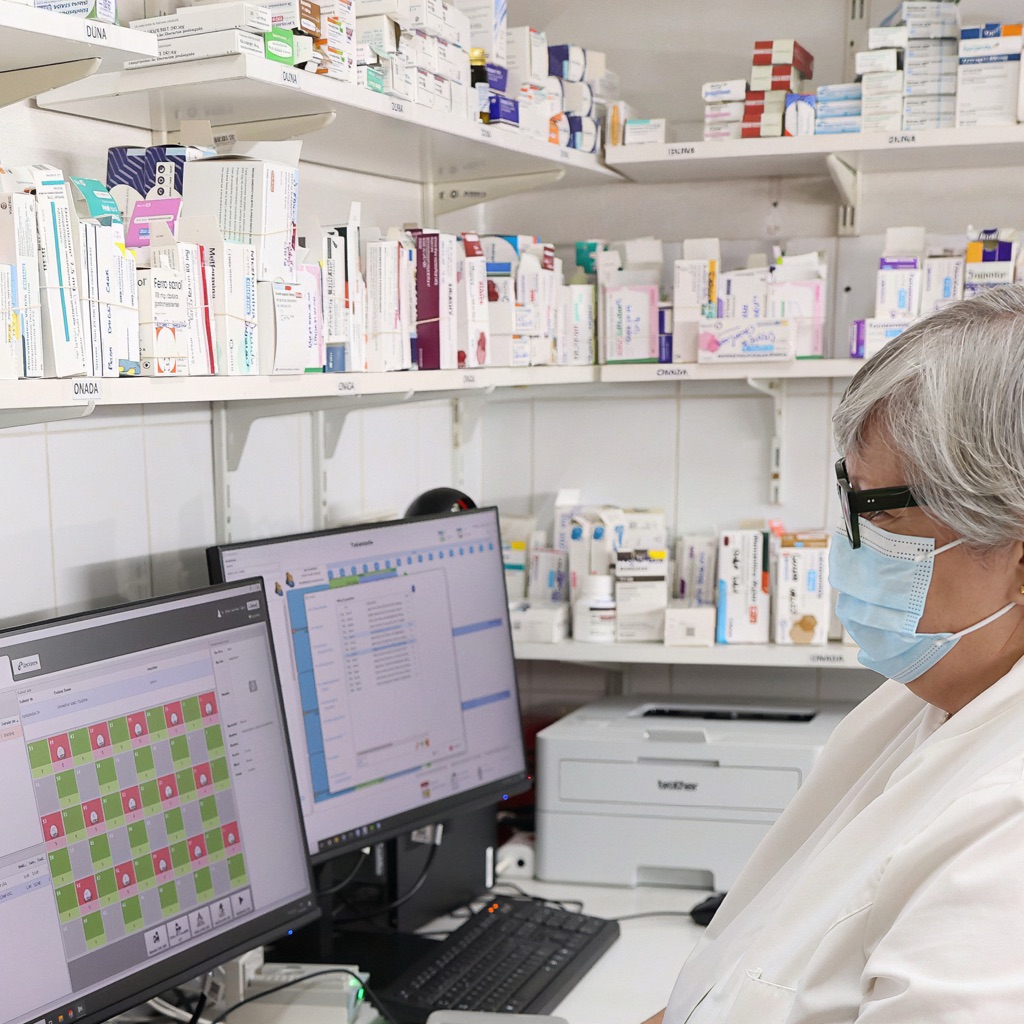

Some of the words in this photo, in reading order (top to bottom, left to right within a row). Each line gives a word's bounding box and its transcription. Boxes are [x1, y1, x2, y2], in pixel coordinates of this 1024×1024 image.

[86, 25, 107, 40] DUNA
[282, 71, 297, 84] DUNA
[154, 278, 167, 289] Ferro
[73, 382, 99, 395] ONADA
